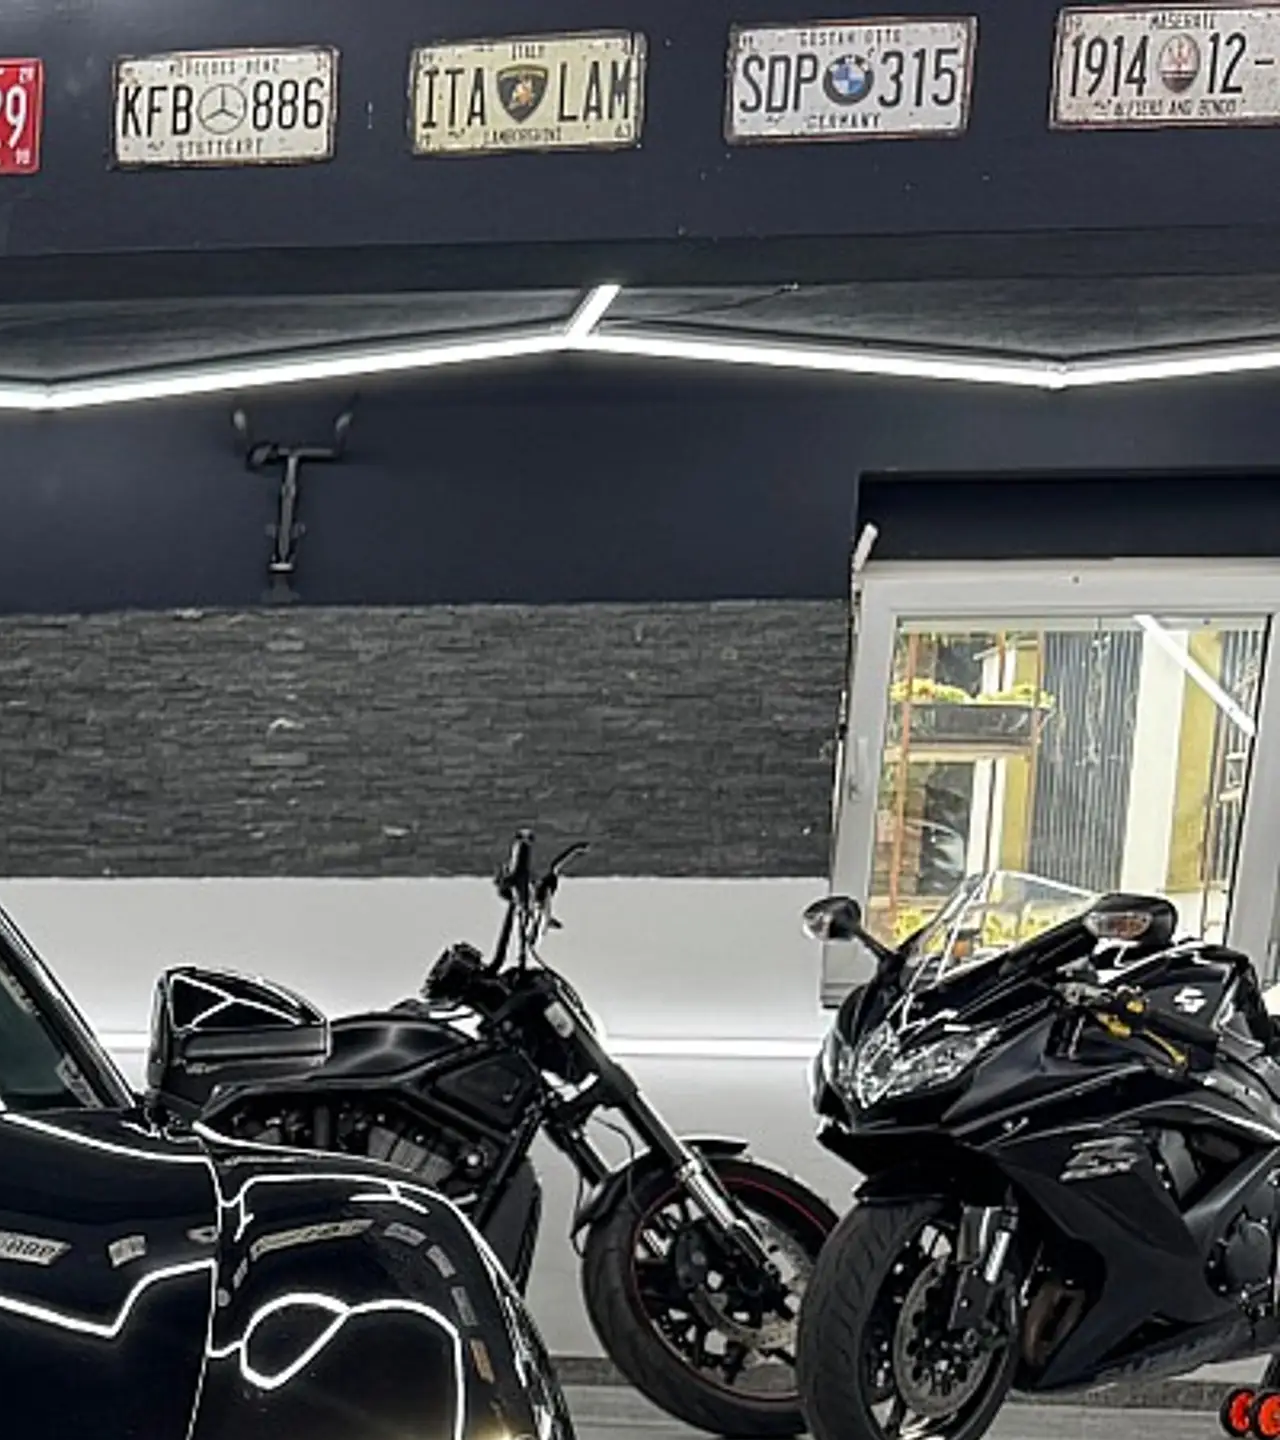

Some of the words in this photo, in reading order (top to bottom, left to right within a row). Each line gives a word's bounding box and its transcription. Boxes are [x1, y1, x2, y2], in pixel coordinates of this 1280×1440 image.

[511, 43, 546, 61] ITALY
[740, 53, 819, 114] SDP
[878, 48, 958, 108] 315
[1070, 34, 1149, 97] 1914
[122, 84, 194, 137] KFB
[252, 77, 324, 130] 886
[422, 67, 485, 129] ITA
[558, 60, 632, 122] LAM
[807, 112, 881, 129] GERMANY
